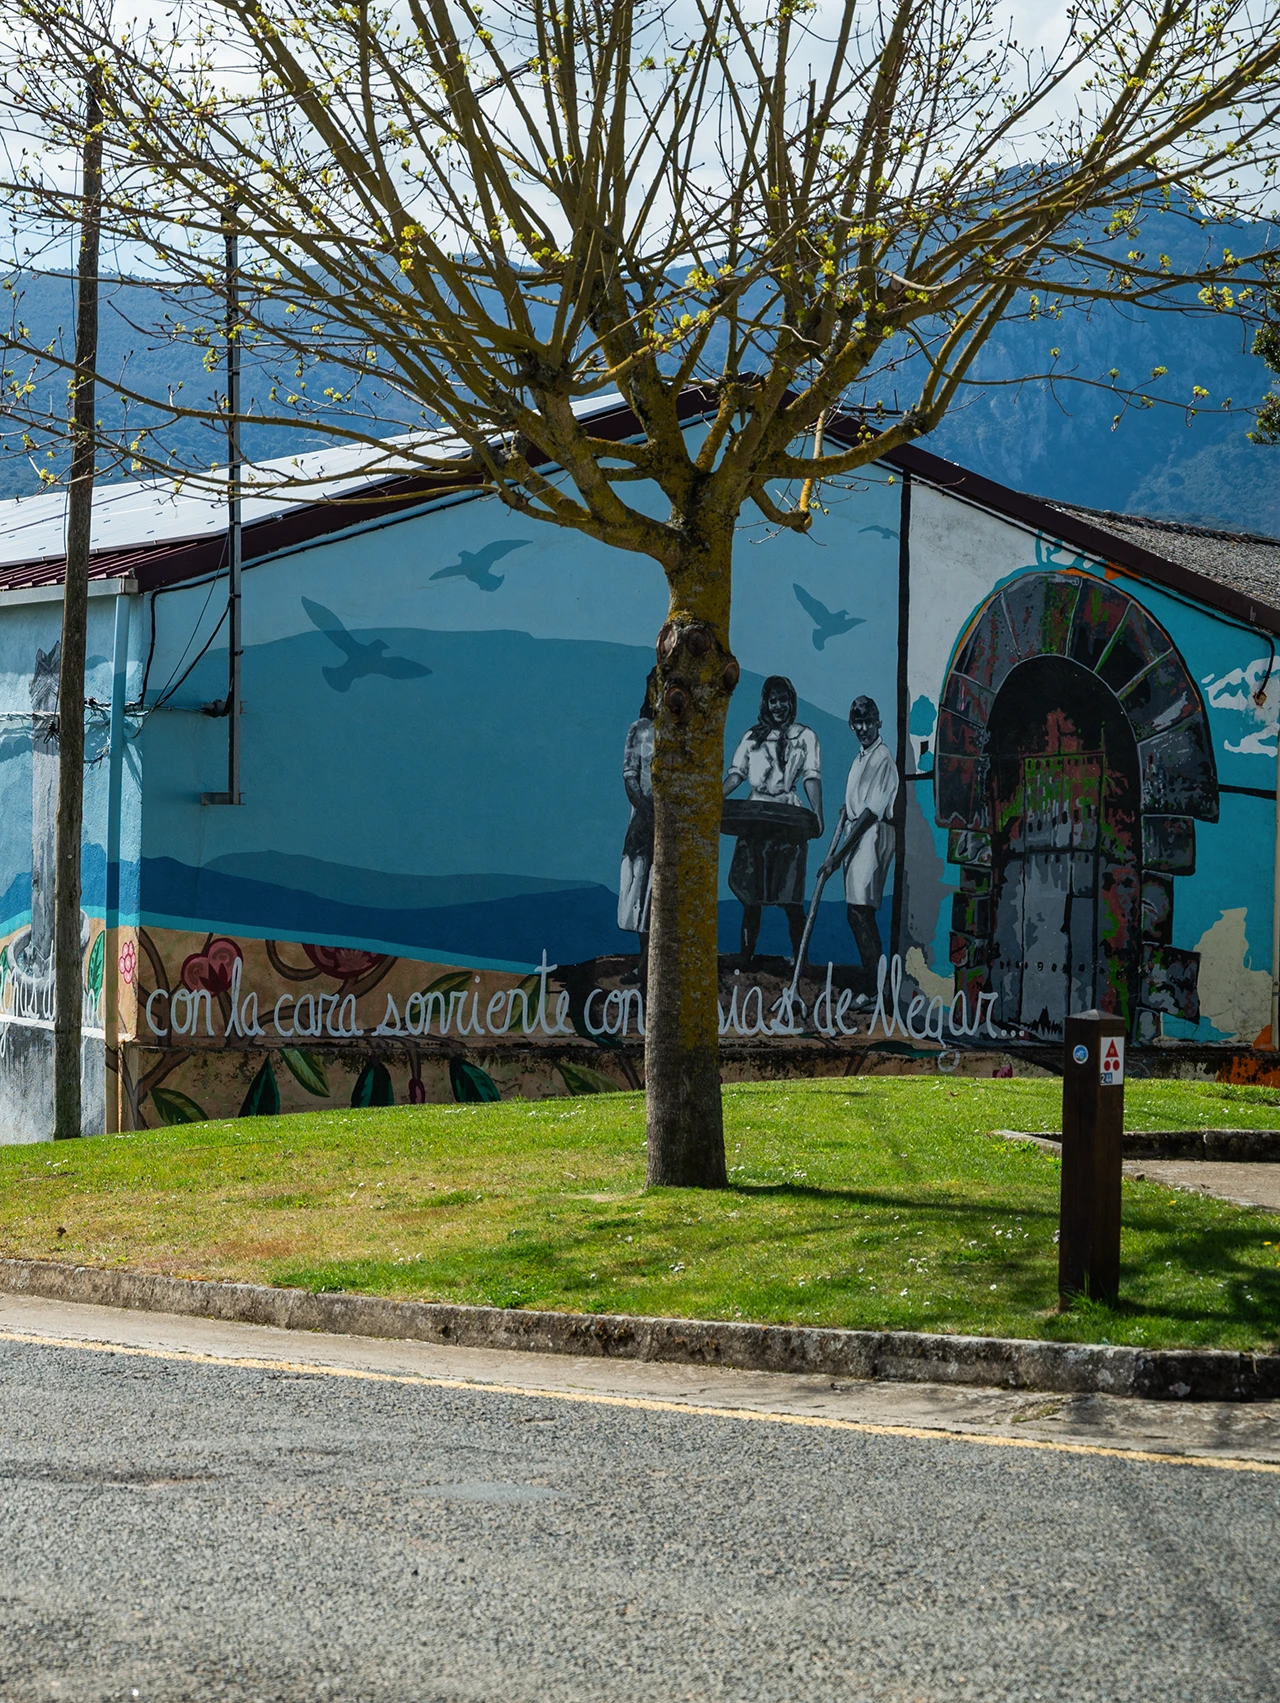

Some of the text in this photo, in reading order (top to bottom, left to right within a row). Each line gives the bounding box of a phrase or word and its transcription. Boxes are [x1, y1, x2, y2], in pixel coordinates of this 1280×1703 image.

[146, 989, 215, 1036] con
[225, 956, 266, 1037] la
[274, 993, 365, 1037] cara
[371, 949, 574, 1036] sonriente
[584, 989, 646, 1036] con
[813, 962, 858, 1036] de
